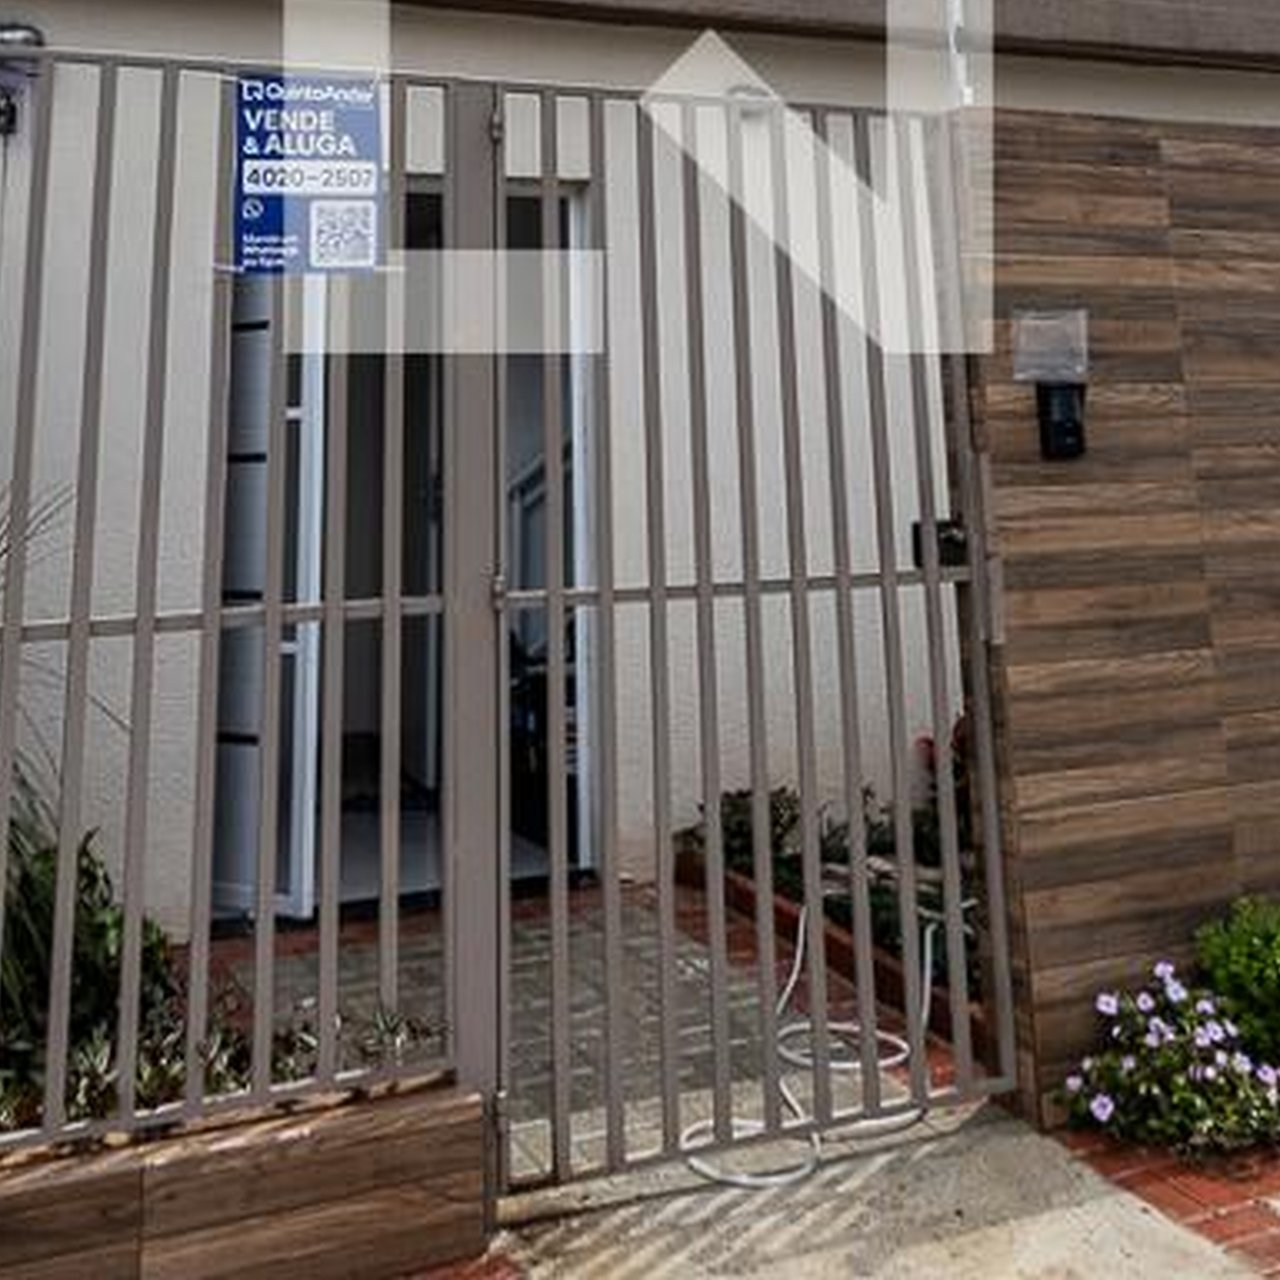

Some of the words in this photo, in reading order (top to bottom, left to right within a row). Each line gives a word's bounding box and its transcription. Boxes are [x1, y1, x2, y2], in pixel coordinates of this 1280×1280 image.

[243, 109, 336, 131] VENDE
[242, 136, 260, 155] &
[262, 133, 357, 156] ALUGA
[245, 168, 373, 188] 4020-2507
